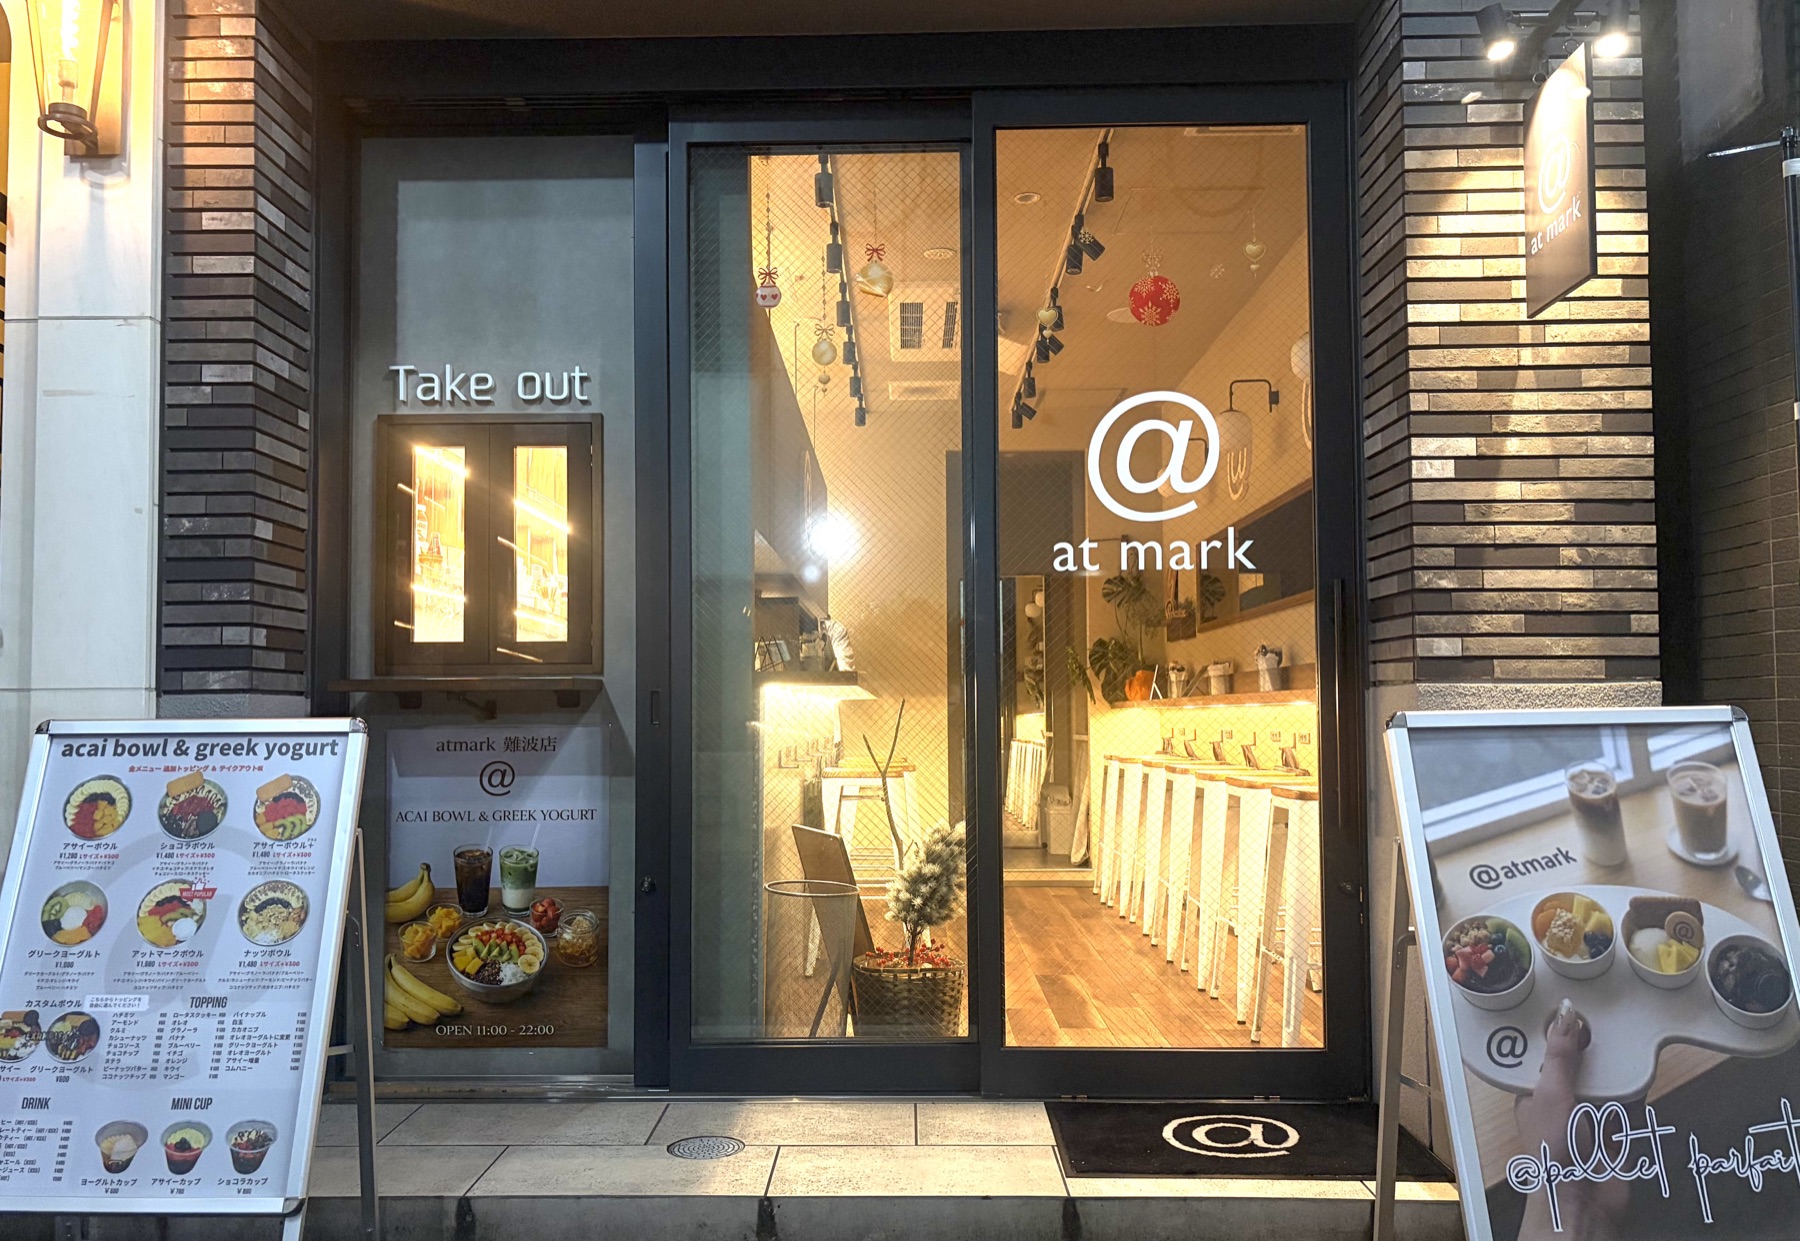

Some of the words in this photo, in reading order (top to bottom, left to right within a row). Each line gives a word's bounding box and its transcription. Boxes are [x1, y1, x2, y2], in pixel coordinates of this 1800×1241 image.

[1530, 230, 1543, 255] at
[1546, 196, 1581, 242] mark
[389, 364, 494, 401] Take
[517, 366, 588, 400] out
[1088, 390, 1220, 522] @
[1053, 536, 1100, 572] at
[1120, 526, 1256, 570] mark
[61, 738, 108, 757] acai
[112, 738, 168, 757] bowl
[173, 739, 190, 757] &
[194, 738, 260, 761] greek
[264, 739, 338, 761] yogurt
[436, 737, 496, 752] atmark
[503, 736, 557, 752] 難波店
[479, 760, 515, 796] @
[396, 810, 428, 822] ACAI
[432, 810, 475, 822] BOWL
[478, 810, 490, 822] &
[492, 810, 537, 822] GREEK
[541, 809, 597, 821] YOGURT
[1469, 846, 1578, 890] @atmark
[28, 950, 100, 958] グリークヨーグルト
[132, 950, 204, 958] アットマークボウル
[244, 949, 291, 958] ナッツボウル
[190, 996, 228, 1008] TOPPING
[436, 1025, 472, 1035] OPEN
[477, 1025, 507, 1035] 11:00
[519, 1025, 554, 1035] 22:00
[1486, 1026, 1528, 1068] @
[21, 1097, 51, 1110] DRINK
[171, 1098, 192, 1110] MINI
[194, 1097, 213, 1110] CUP
[1162, 1114, 1300, 1158] @
[1688, 1098, 1800, 1223] parfait
[81, 1178, 138, 1187] ヨーグルトカップ
[151, 1178, 202, 1186] アサイーカップ
[218, 1178, 268, 1186] ショコラカップ
